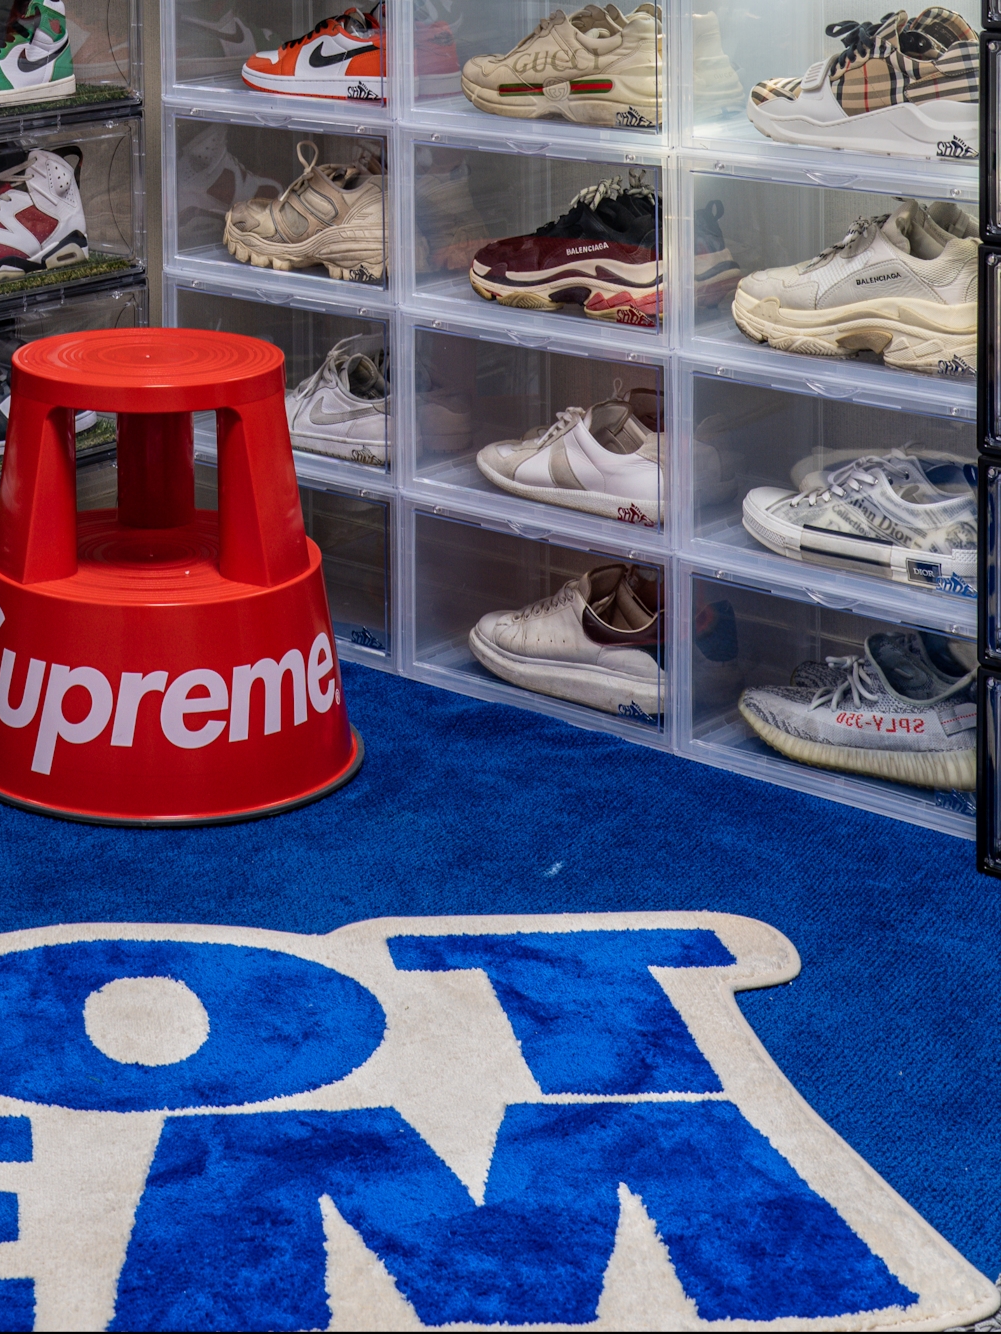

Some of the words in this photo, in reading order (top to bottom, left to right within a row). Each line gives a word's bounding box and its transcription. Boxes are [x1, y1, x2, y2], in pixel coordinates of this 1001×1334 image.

[513, 48, 601, 74] GUCCI
[566, 242, 609, 256] BALENCIAGA
[856, 272, 901, 285] BALENCIAGA
[877, 512, 912, 547] Dior
[912, 566, 935, 578] DIOR
